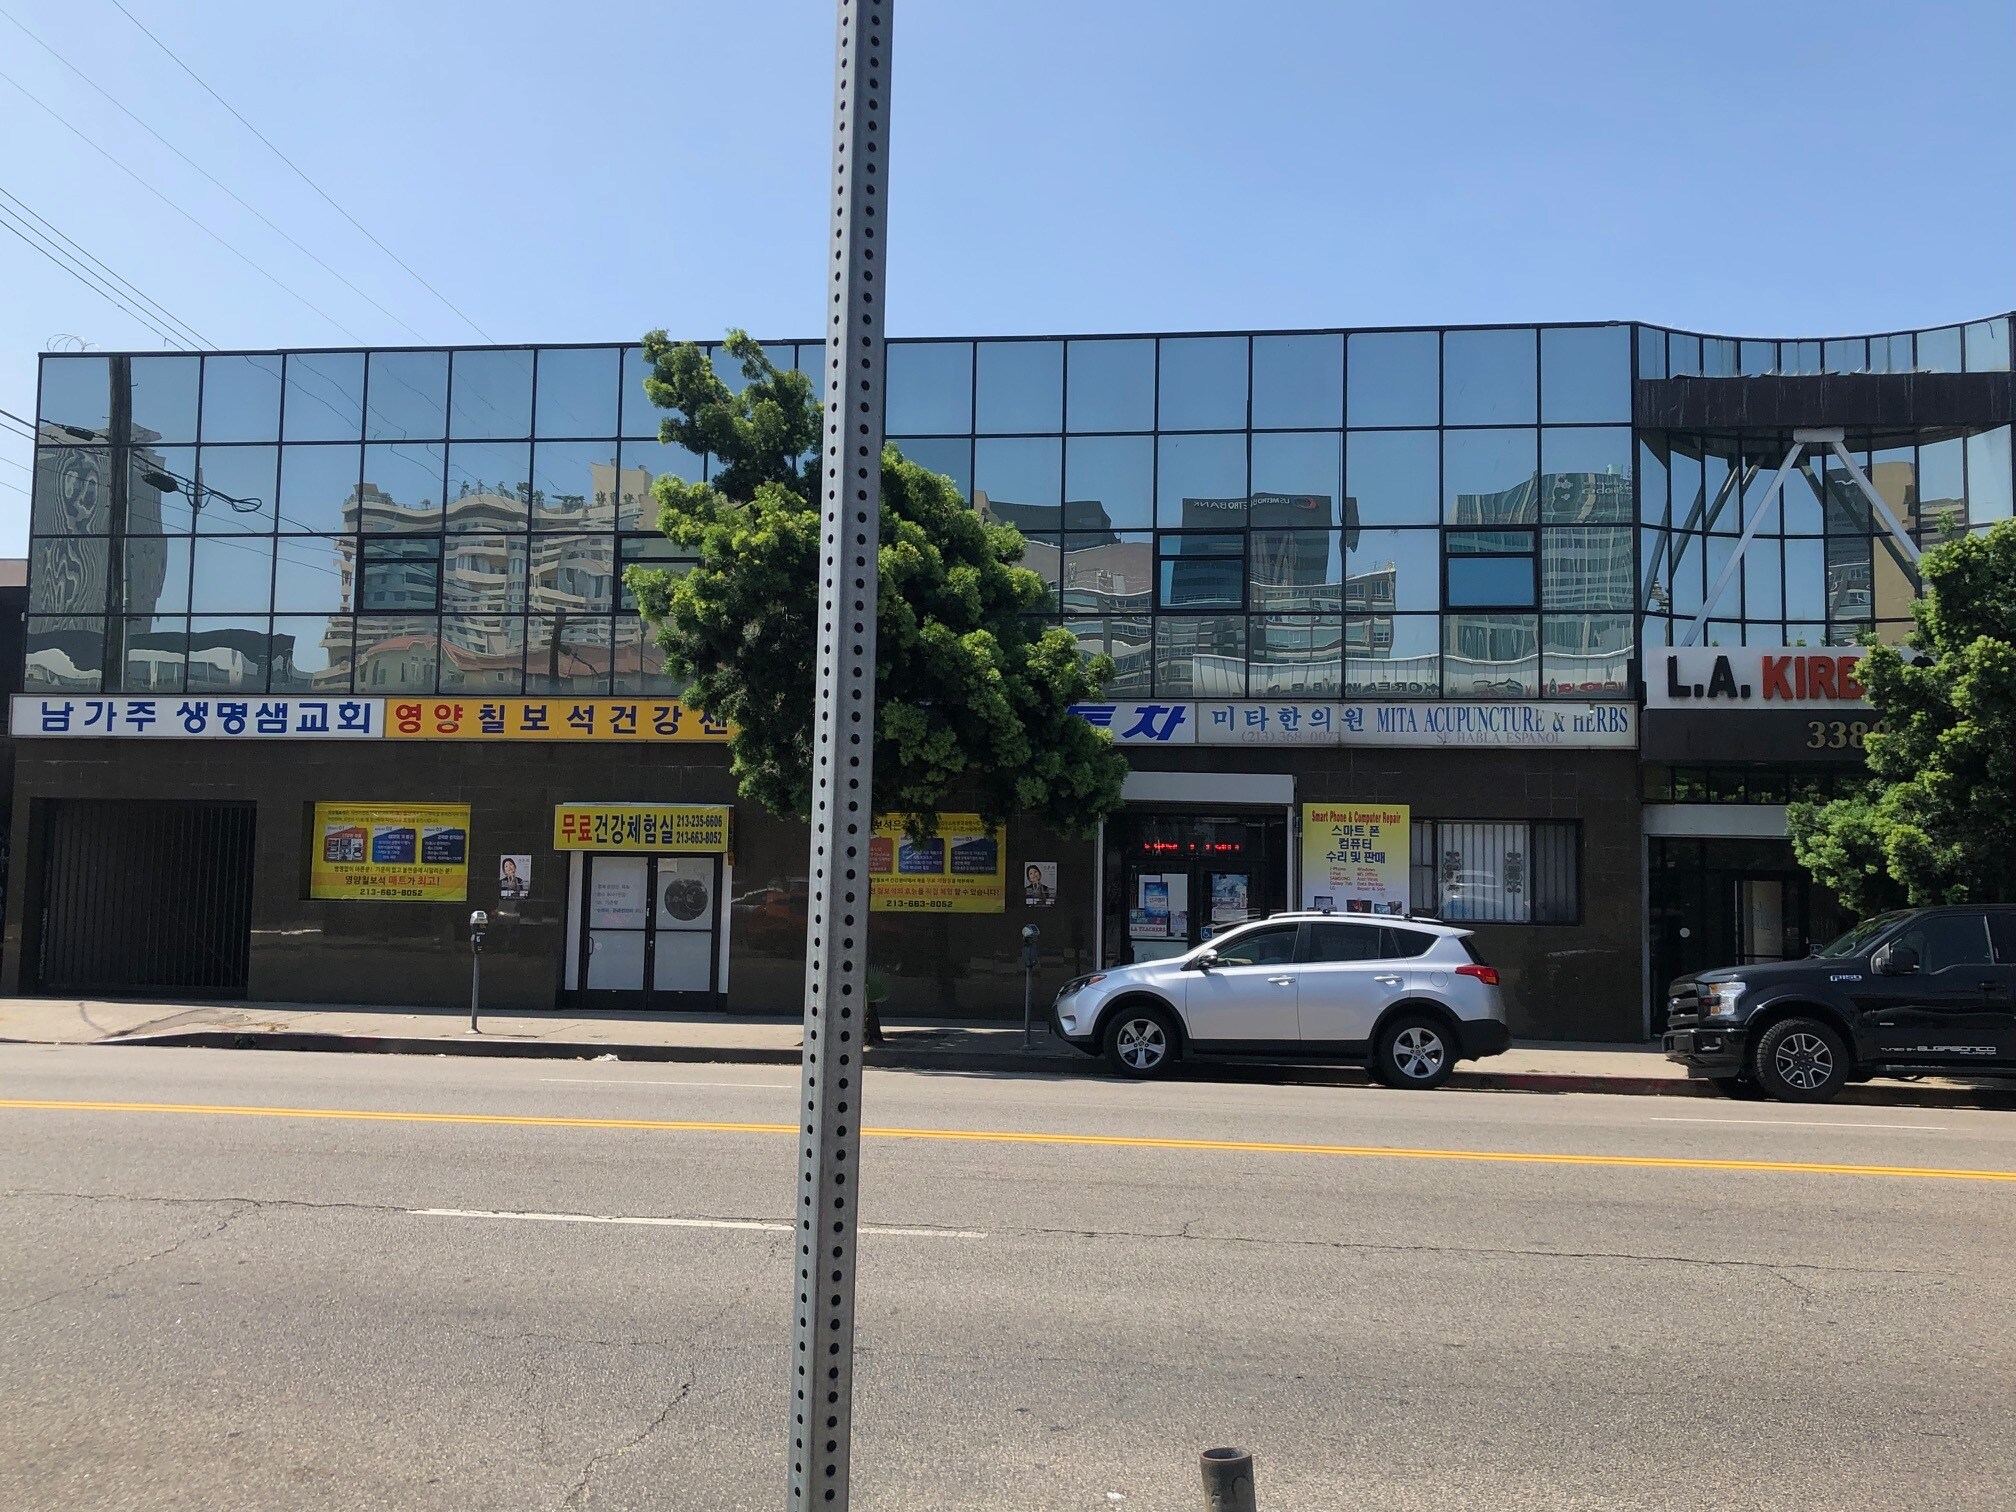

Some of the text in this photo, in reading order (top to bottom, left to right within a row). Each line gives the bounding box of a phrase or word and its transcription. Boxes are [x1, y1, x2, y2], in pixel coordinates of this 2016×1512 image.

[1667, 655, 1866, 700] L.A. KIRB
[41, 701, 372, 735] 남가주 생명샘교회
[1211, 704, 1364, 733] 미타한의원
[1376, 706, 1628, 733] MITA ACUPUNCTURE & HERBS
[1241, 731, 1275, 743] (213)
[1436, 732, 1451, 744] SE
[1456, 732, 1501, 744] HABLA
[1312, 810, 1401, 826] Smart Phone & Computer Repair
[873, 819, 904, 831] 보석은
[1331, 825, 1380, 837] 스마트 폰
[675, 831, 722, 844] 213-663-8052
[1338, 838, 1372, 850] 컴퓨터
[1326, 851, 1347, 863] 수리
[1364, 851, 1386, 864] 판매
[345, 875, 386, 885] 영양칠보석
[418, 875, 440, 886] 최고!
[359, 888, 423, 897] 213-663-8052
